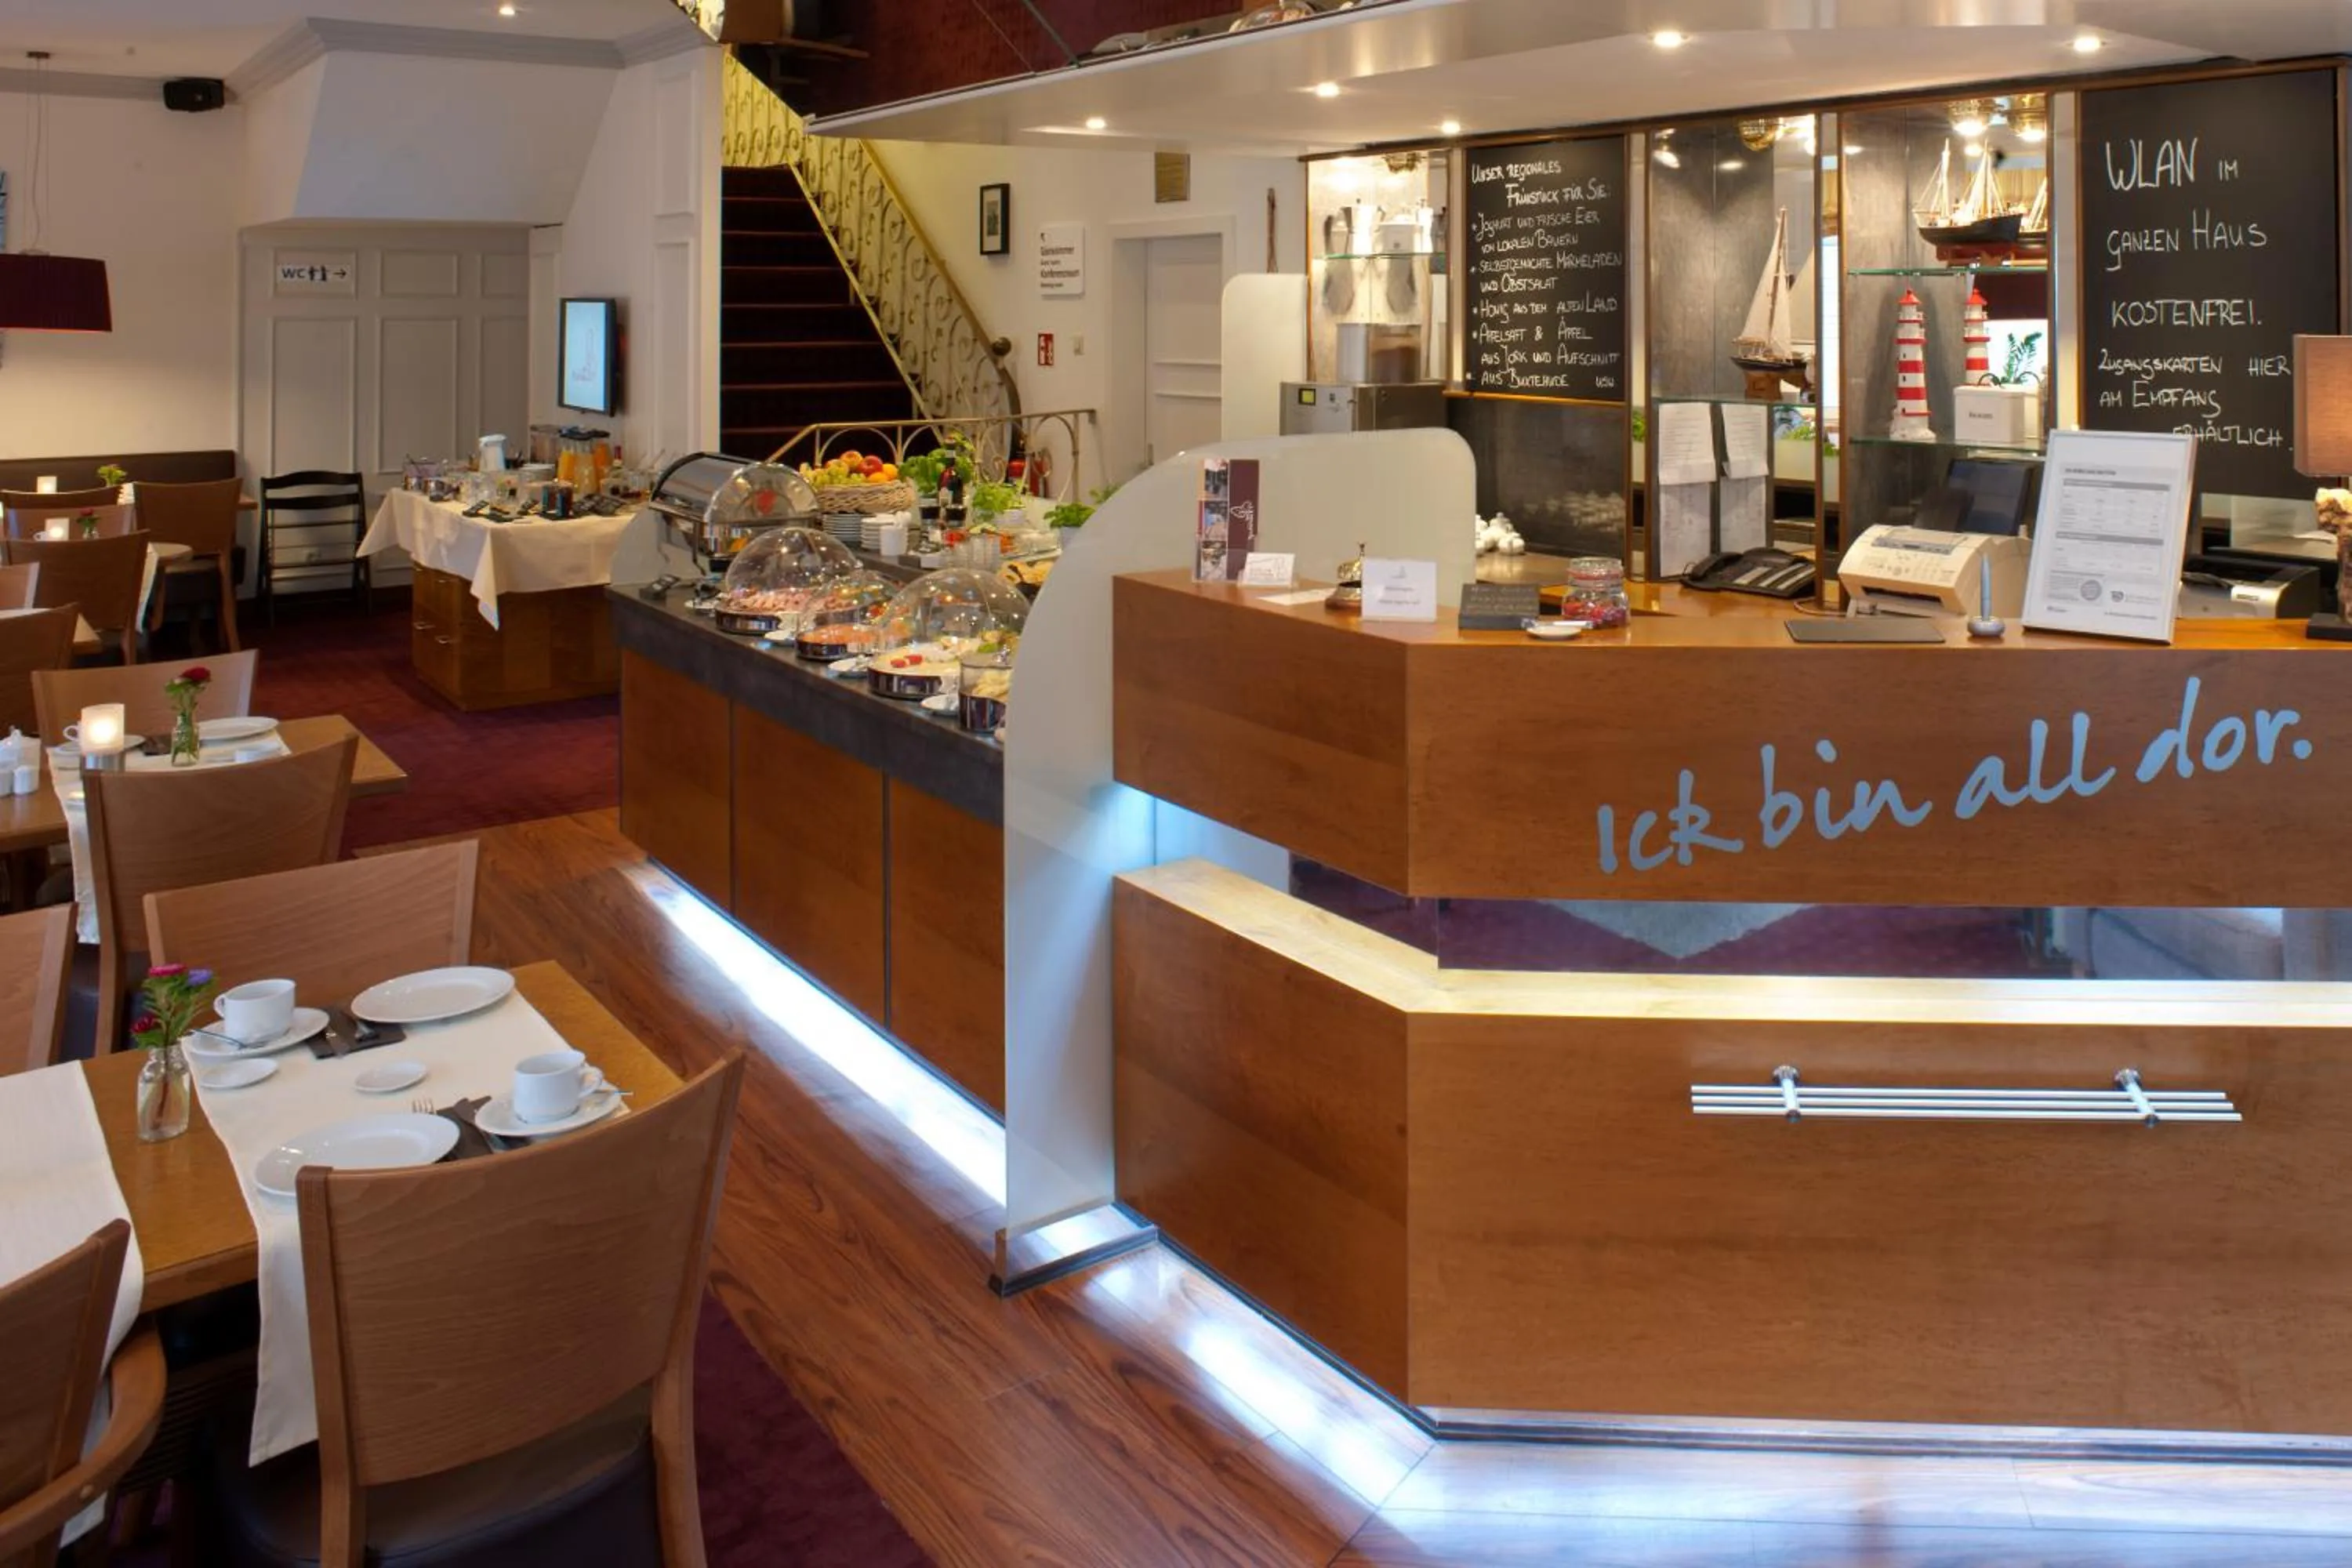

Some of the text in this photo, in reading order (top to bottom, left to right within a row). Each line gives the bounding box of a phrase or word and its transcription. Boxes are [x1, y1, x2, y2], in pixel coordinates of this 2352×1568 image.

[2106, 137, 2239, 191] WLAN IM
[2192, 208, 2267, 250] HAUS
[2111, 299, 2263, 328] KOSTENFREI.
[1534, 325, 1544, 341] &
[2248, 355, 2292, 376] HIER
[2100, 390, 2122, 407] AM
[1596, 676, 2314, 875] Ick bin all dor.
